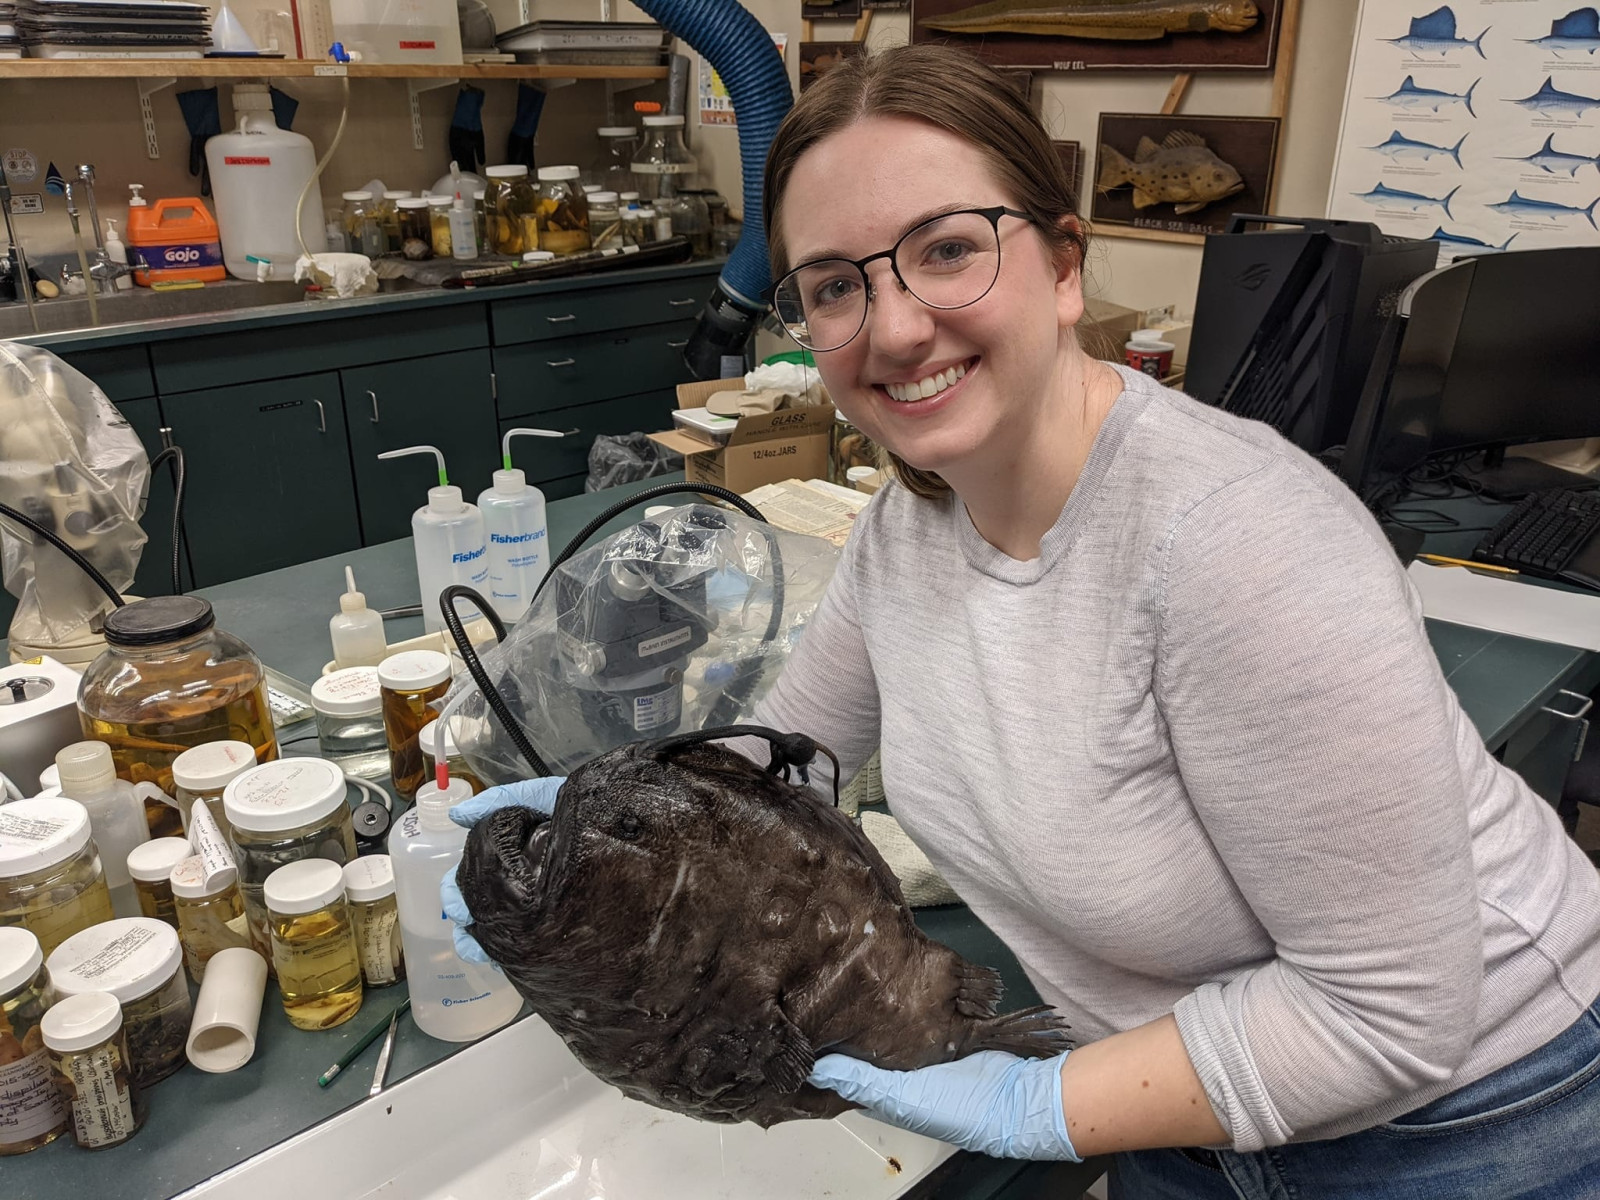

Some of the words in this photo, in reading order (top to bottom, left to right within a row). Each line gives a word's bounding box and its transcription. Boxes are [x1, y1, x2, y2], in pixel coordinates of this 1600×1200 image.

[1054, 61, 1070, 70] WOLF
[1071, 61, 1085, 70] EEL
[10, 151, 27, 159] STOP
[1133, 217, 1162, 229] BLACK
[1167, 221, 1184, 232] SEA
[1189, 223, 1213, 234] BASS
[771, 413, 806, 427] GLASS
[491, 526, 546, 544] Fisherbrand
[452, 998, 469, 1006] Fisher
[469, 992, 491, 1003] Scientific
